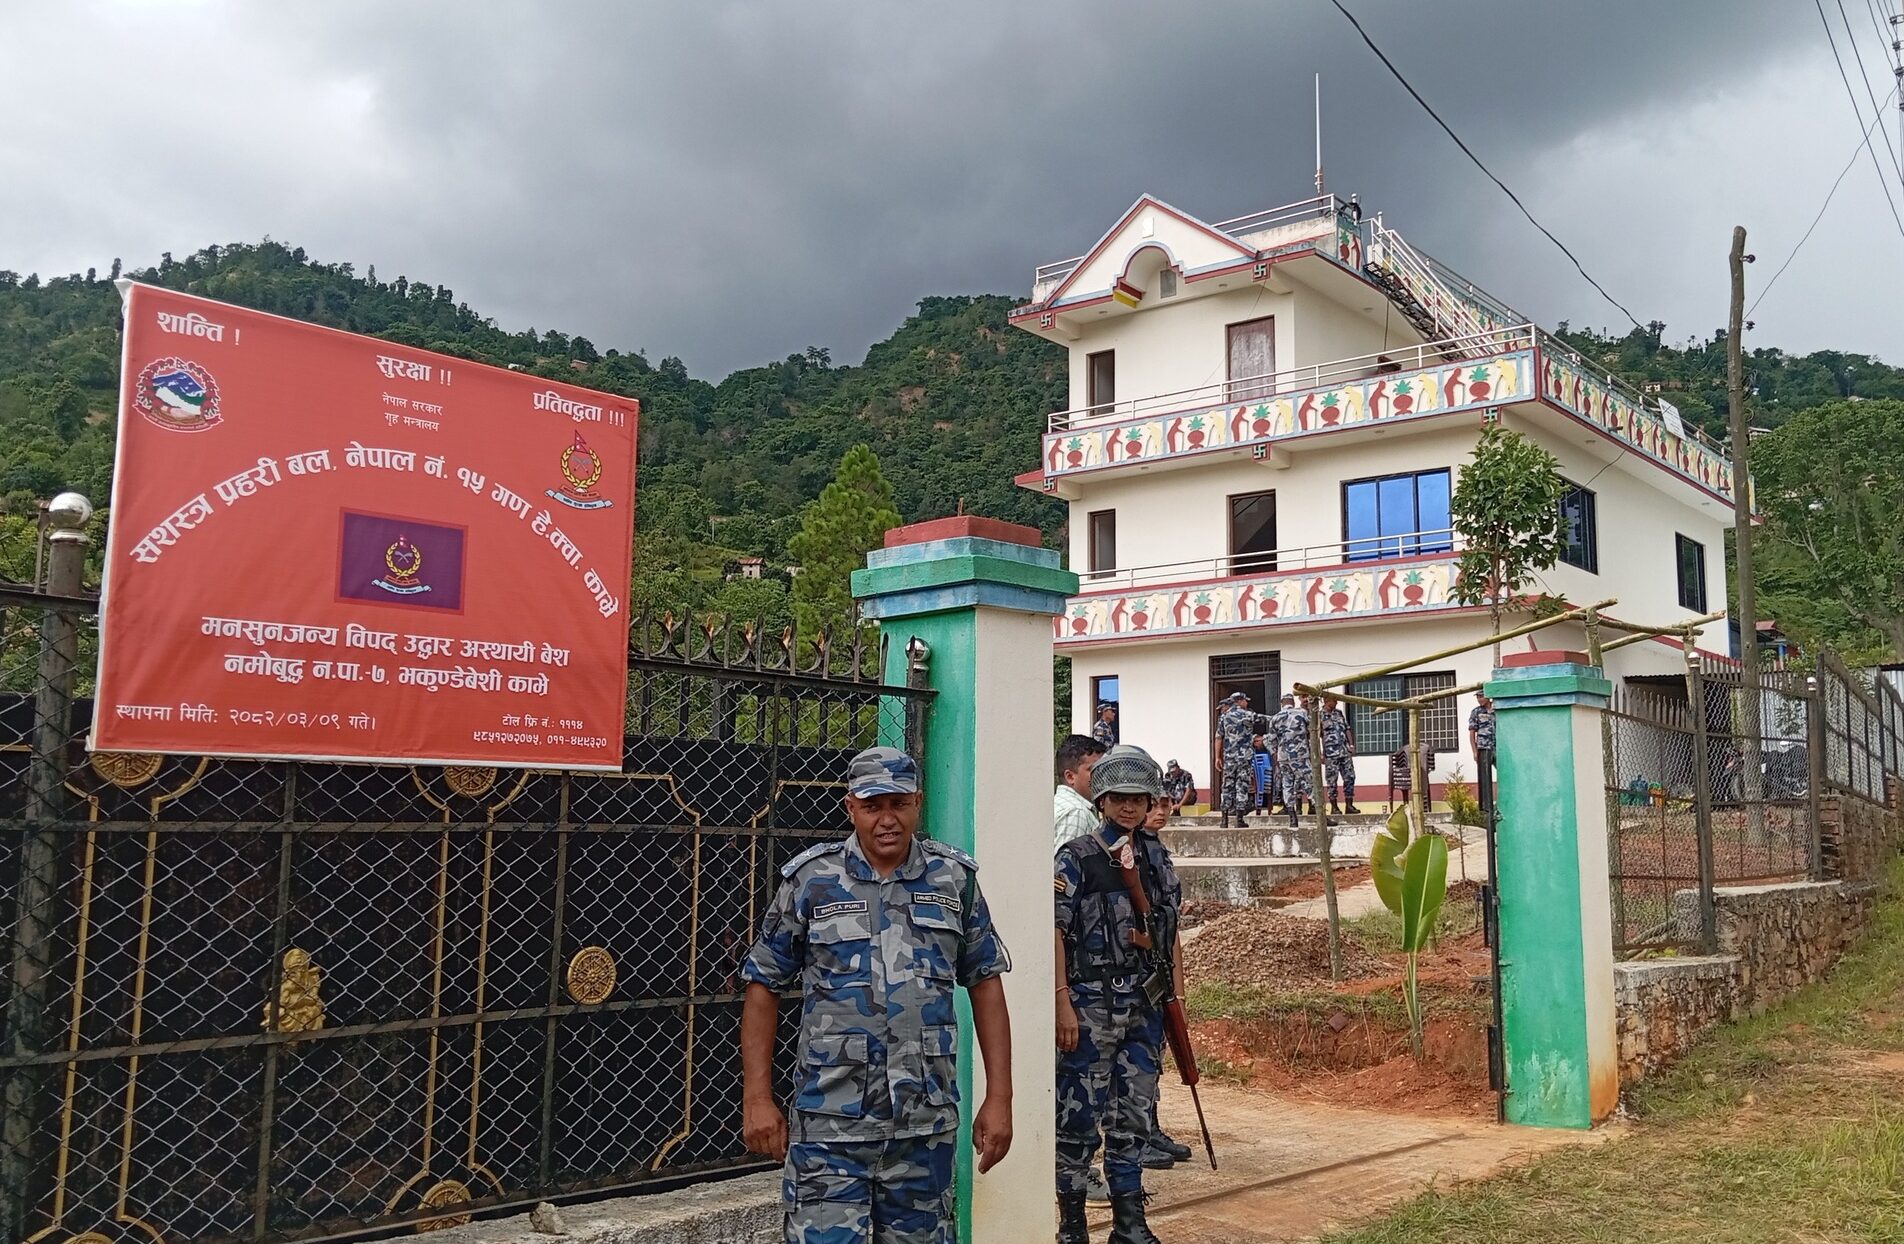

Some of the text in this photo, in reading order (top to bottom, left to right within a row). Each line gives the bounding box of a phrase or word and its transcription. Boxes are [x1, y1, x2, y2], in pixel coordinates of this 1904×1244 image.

[157, 312, 225, 342] शान्ति
[376, 355, 432, 381] सुरक्षा
[382, 392, 443, 415] नेपाल सरकार
[384, 412, 439, 431] गृह मन्त्रालय
[129, 493, 214, 563] सशस्त्र
[213, 457, 281, 506] प्रहरी
[344, 441, 416, 471] नेपाल
[424, 456, 448, 478] नं.
[457, 467, 485, 494] १५
[491, 483, 532, 519] गण
[201, 617, 570, 666] मनसुनजन्य विपद् उद्धार अस्थायी बेश
[224, 651, 306, 684] नमोबुद्ध
[398, 665, 502, 692] भकुण्डेबेशी
[508, 673, 549, 696] काभ्रे
[116, 704, 173, 721] स्थापना
[229, 709, 340, 729] २०८२/०३/०९
[503, 714, 521, 726] टोल
[524, 714, 538, 727] फ्रि
[560, 720, 583, 729] १११४
[547, 735, 607, 748] ०११-४९९३२०
